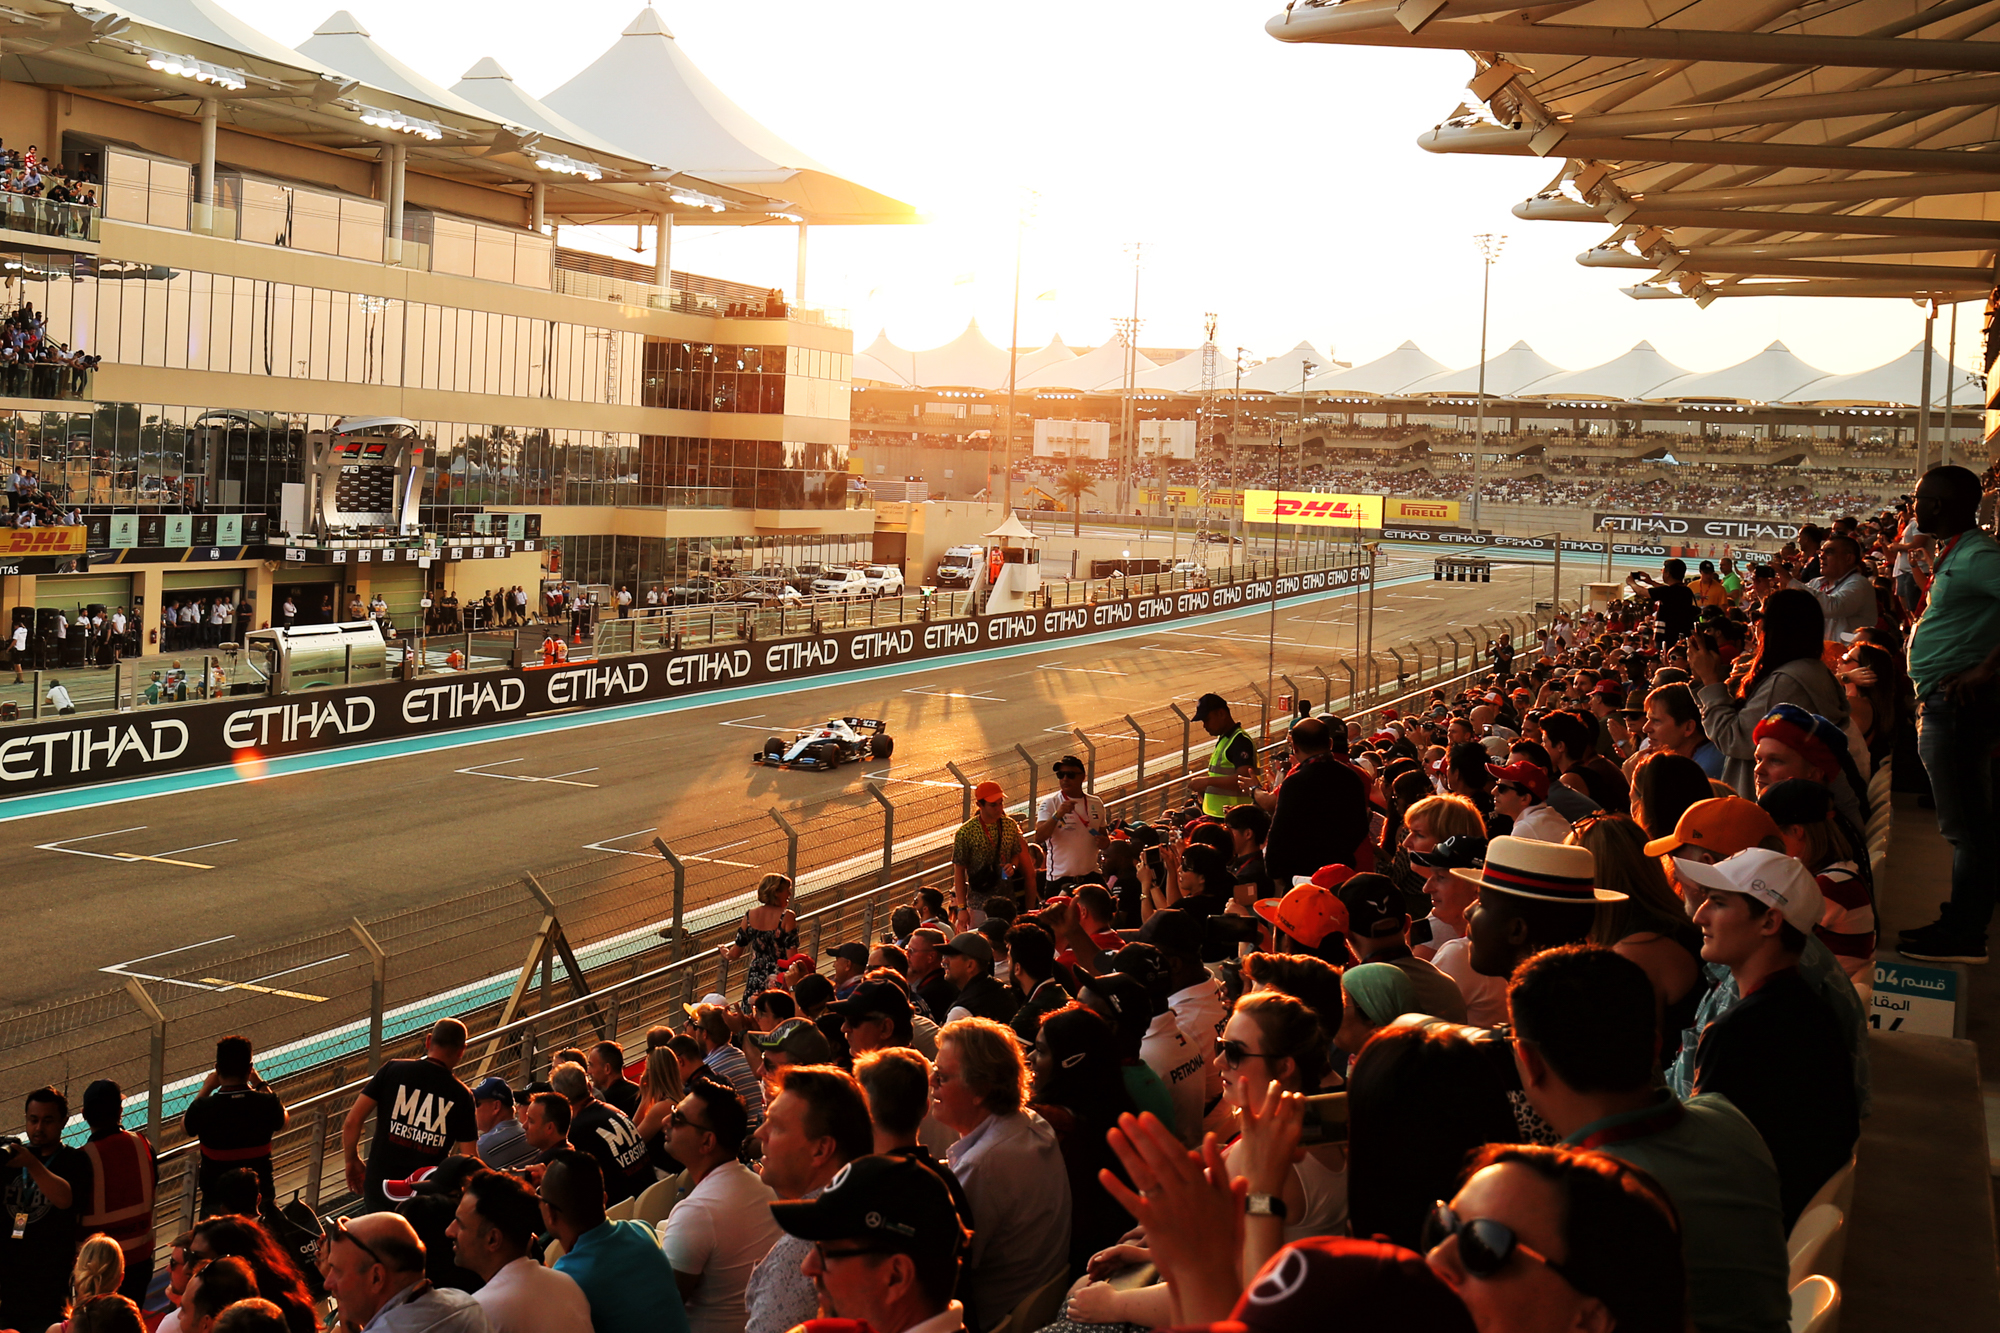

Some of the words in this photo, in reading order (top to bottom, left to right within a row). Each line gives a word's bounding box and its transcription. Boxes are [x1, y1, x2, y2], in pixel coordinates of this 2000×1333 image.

[1273, 499, 1362, 519] DHL
[1401, 503, 1448, 518] PIRELLI
[1601, 516, 1689, 534] ETIHAD
[1704, 521, 1798, 540] ETIHAD
[9, 532, 71, 553] DHL
[1384, 531, 1430, 541] ETIHAD
[1438, 534, 1486, 544] ETIHAD
[1495, 537, 1544, 548] ETIHAD
[1553, 541, 1604, 551] ETIHAD
[1612, 545, 1665, 555] ETIHAD
[1746, 552, 1772, 562] ETIHAD
[0, 719, 189, 781] ETIHAD
[223, 696, 375, 749] ETIHAD
[402, 677, 525, 723] ETIHAD
[547, 663, 649, 704] ETIHAD
[666, 650, 751, 686] ETIHAD
[766, 639, 839, 672] ETIHAD
[851, 629, 914, 660] ETIHAD
[924, 621, 979, 649] ETIHAD
[988, 615, 1036, 640] ETIHAD
[1044, 608, 1087, 632] ETIHAD
[1094, 603, 1132, 625] ETIHAD
[1138, 597, 1173, 619] ETIHAD
[1177, 592, 1209, 613] ETIHAD
[1213, 587, 1242, 606] ETIHAD
[1245, 581, 1272, 600] ETIHAD
[1275, 577, 1299, 594] ETIHAD
[1302, 573, 1325, 590] ETIHAD
[1328, 570, 1348, 585] ETIHAD
[1351, 567, 1370, 582] ETHAD
[1280, 699, 1286, 709] F
[1874, 967, 1899, 986] 04
[1901, 978, 1945, 990] قسم
[391, 1084, 454, 1135] MAX
[389, 1120, 446, 1147] VERSTAPPEN
[300, 1239, 318, 1254] adi
